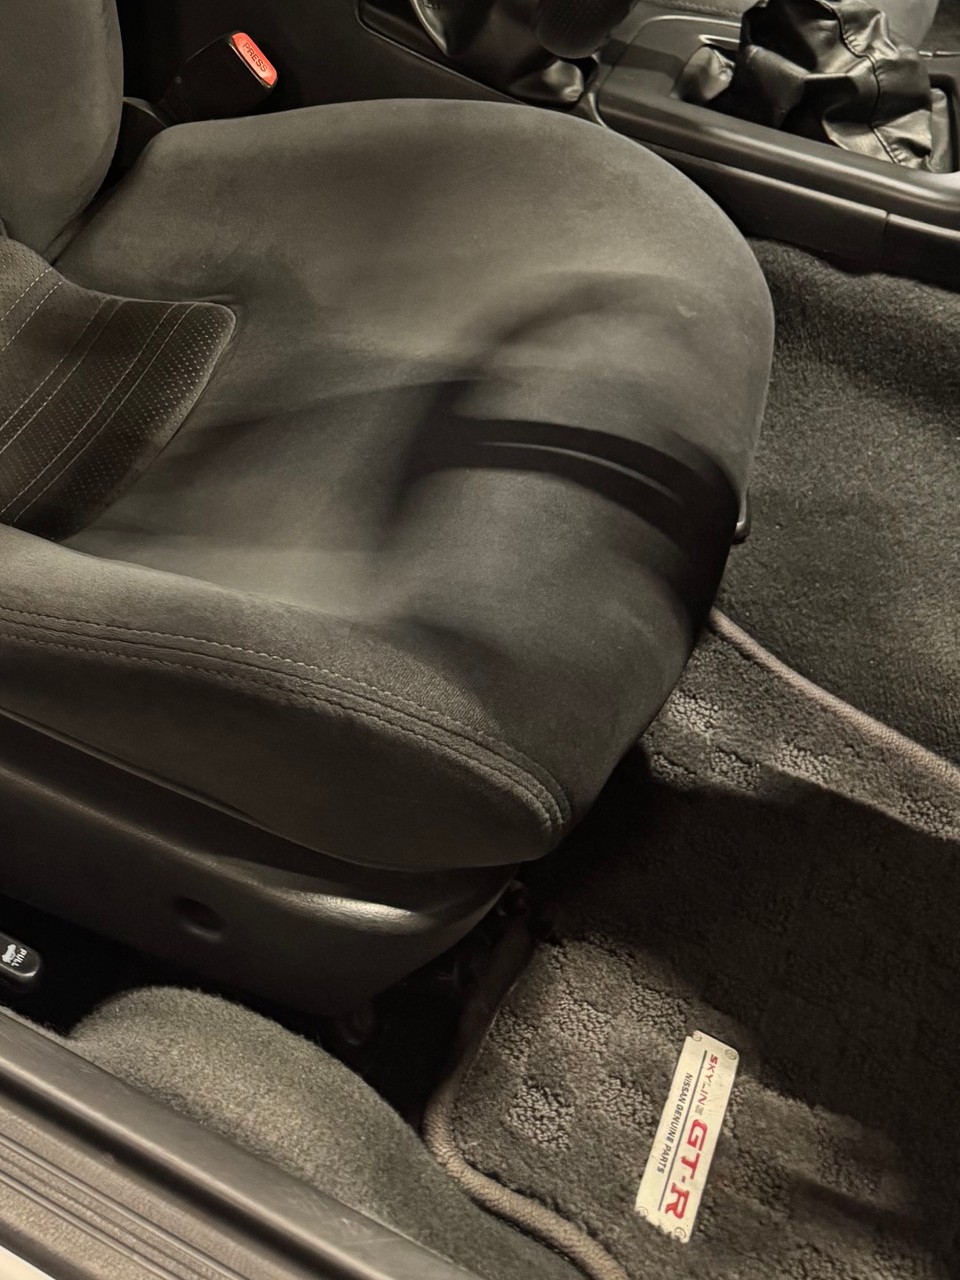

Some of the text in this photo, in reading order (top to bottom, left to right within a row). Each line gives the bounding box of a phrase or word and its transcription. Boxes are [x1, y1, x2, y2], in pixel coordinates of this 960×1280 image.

[242, 42, 268, 72] PRESS
[11, 948, 28, 967] PULL
[656, 1072, 693, 1174] NISSAN GENUINE PARTS
[665, 1054, 719, 1220] SKYLINE GT-R
